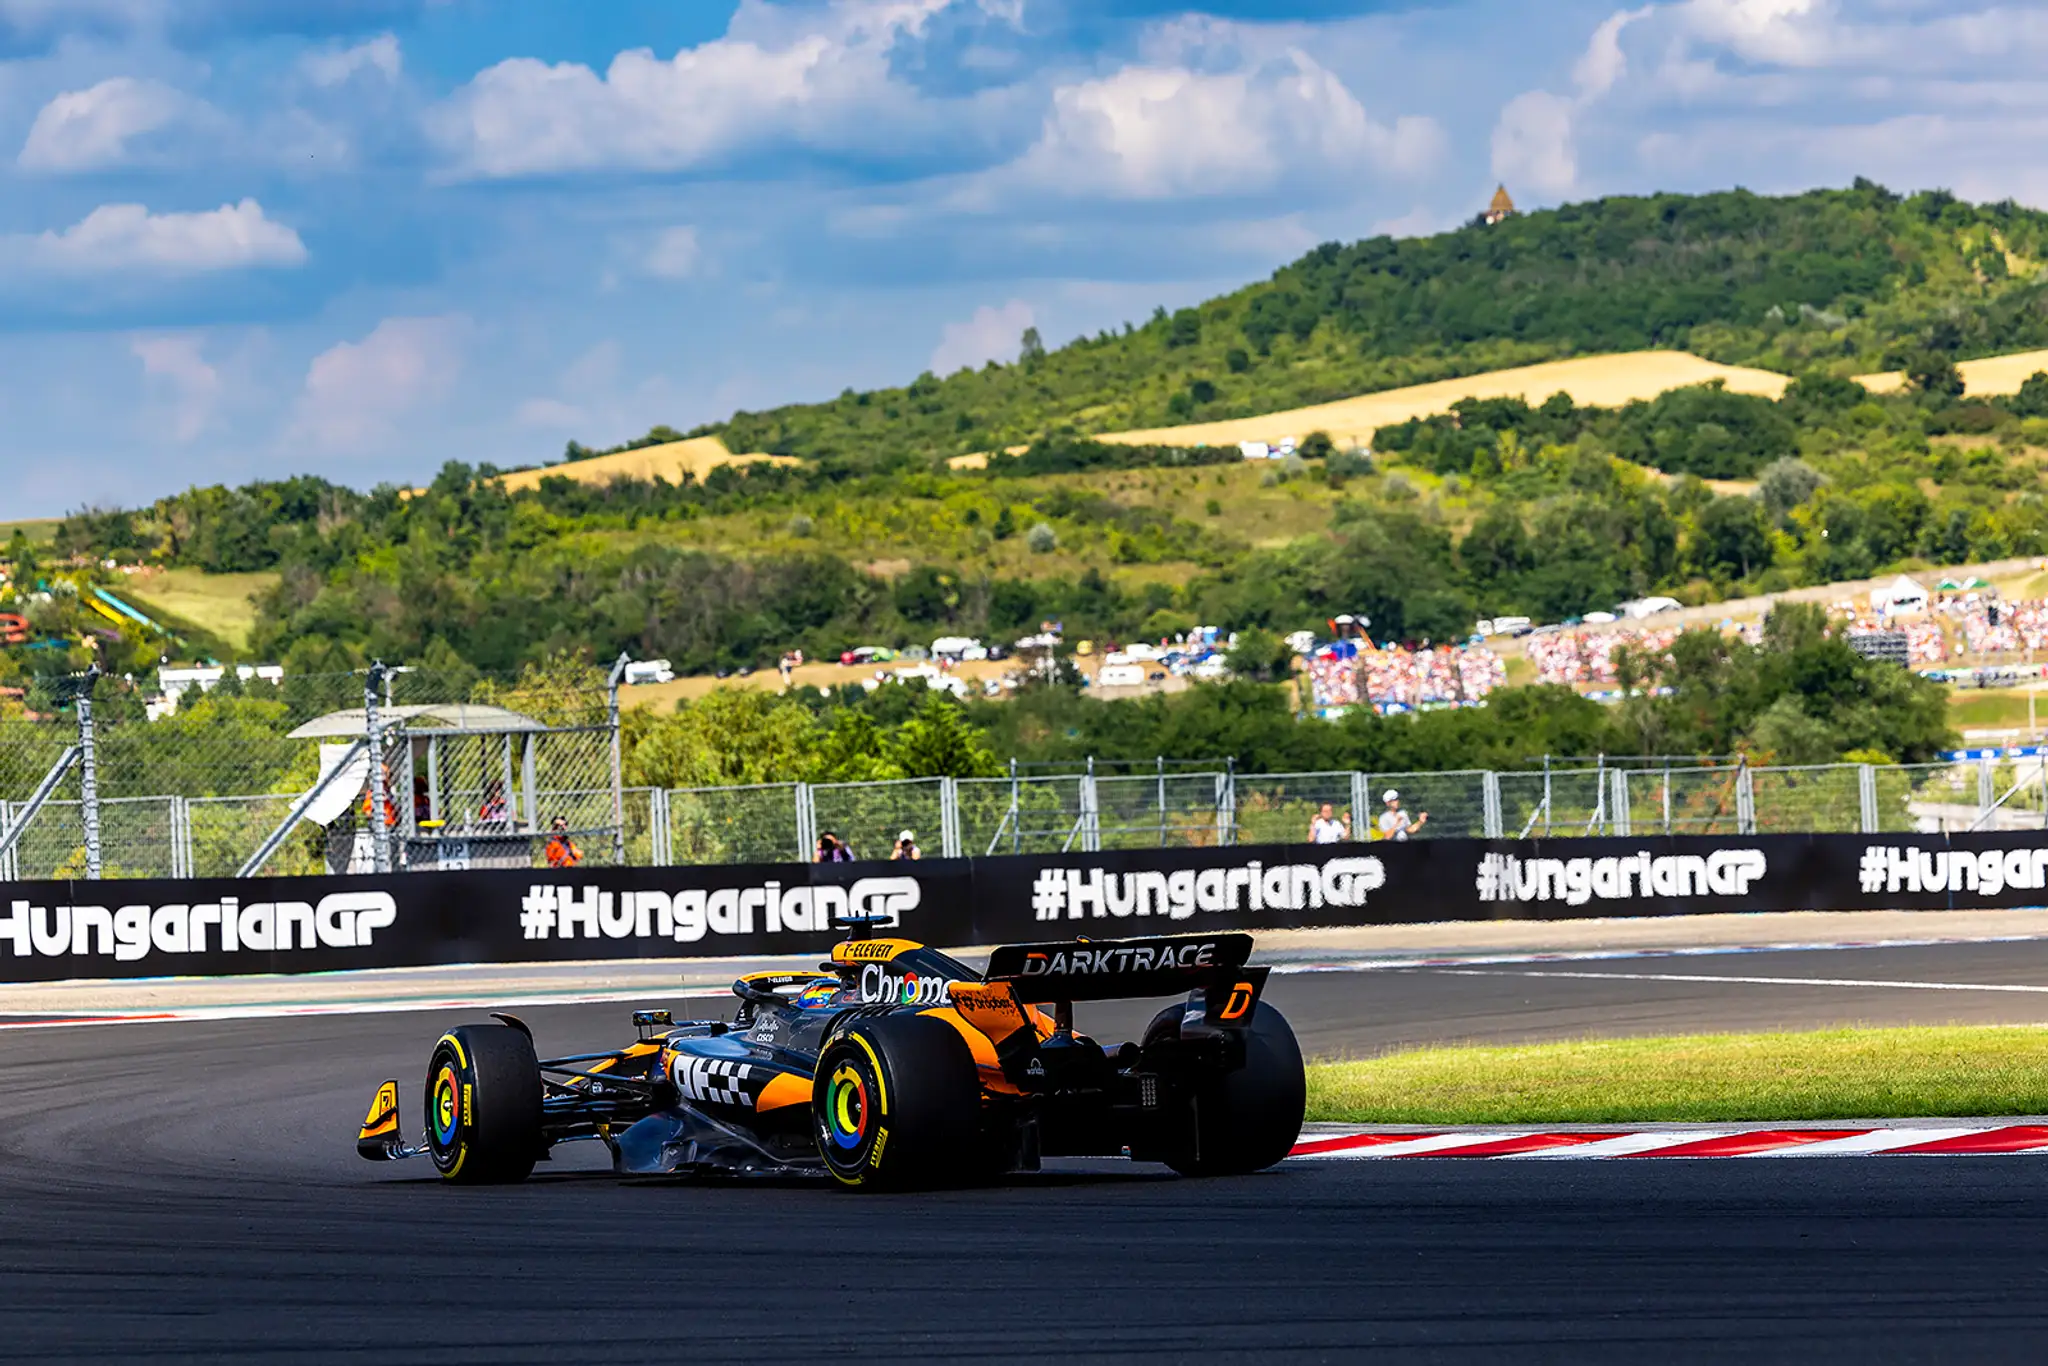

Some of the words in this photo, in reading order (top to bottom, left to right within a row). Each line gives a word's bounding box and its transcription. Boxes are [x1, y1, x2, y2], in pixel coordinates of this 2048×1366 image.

[1031, 855, 1386, 921] #HungarianGP
[1475, 848, 1767, 906] #HungarianGP
[519, 876, 921, 943] #HungarianGP
[861, 963, 960, 1004] Chrome
[1022, 943, 1216, 976] DARKTRACE
